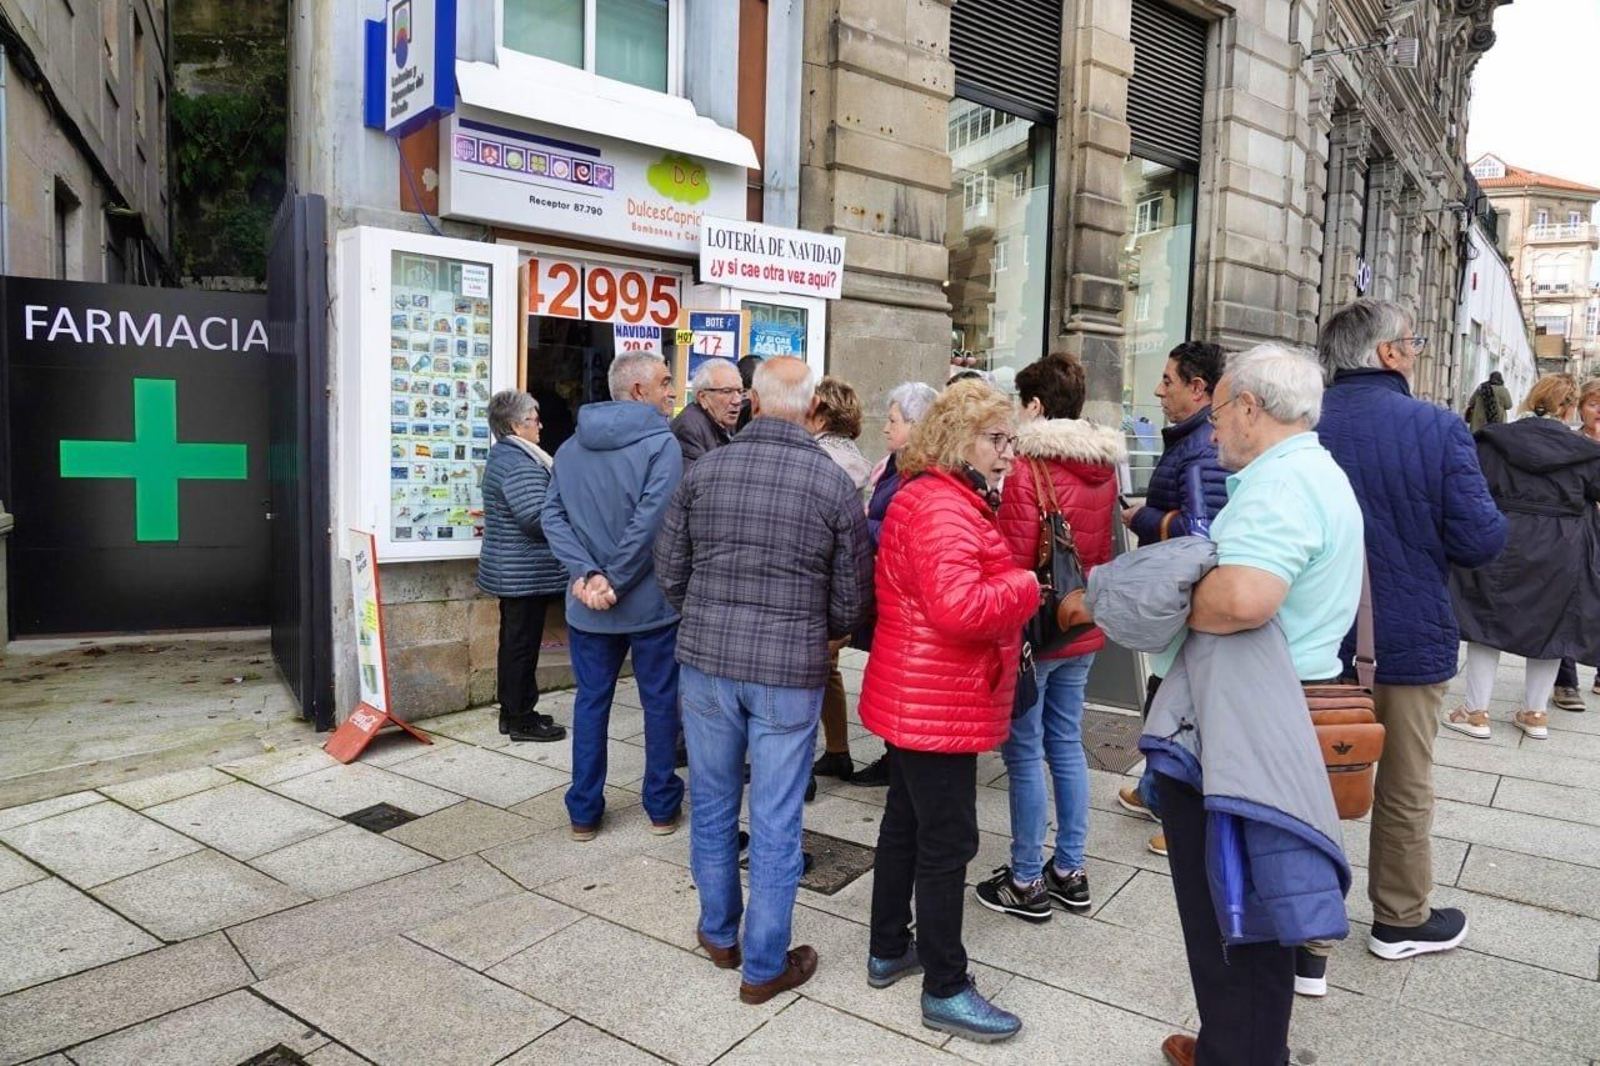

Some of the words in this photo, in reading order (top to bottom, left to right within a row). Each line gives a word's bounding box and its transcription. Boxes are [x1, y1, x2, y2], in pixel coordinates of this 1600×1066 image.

[529, 195, 570, 209] Receptor
[573, 203, 603, 216] 87.790
[627, 198, 704, 228] DulcesCapric
[707, 227, 765, 255] LOTERÍA
[768, 237, 786, 258] DE
[789, 240, 842, 266] NAVIDAD
[711, 259, 725, 278] ¿y
[728, 258, 738, 276] si
[741, 263, 761, 280] cae
[763, 264, 785, 282] otra
[787, 269, 807, 285] vez
[808, 271, 837, 291] aquí?
[24, 304, 269, 352] FARMACIA
[615, 325, 660, 340] NAVIDAD
[705, 316, 725, 329] BOTE
[677, 331, 693, 343] HOY
